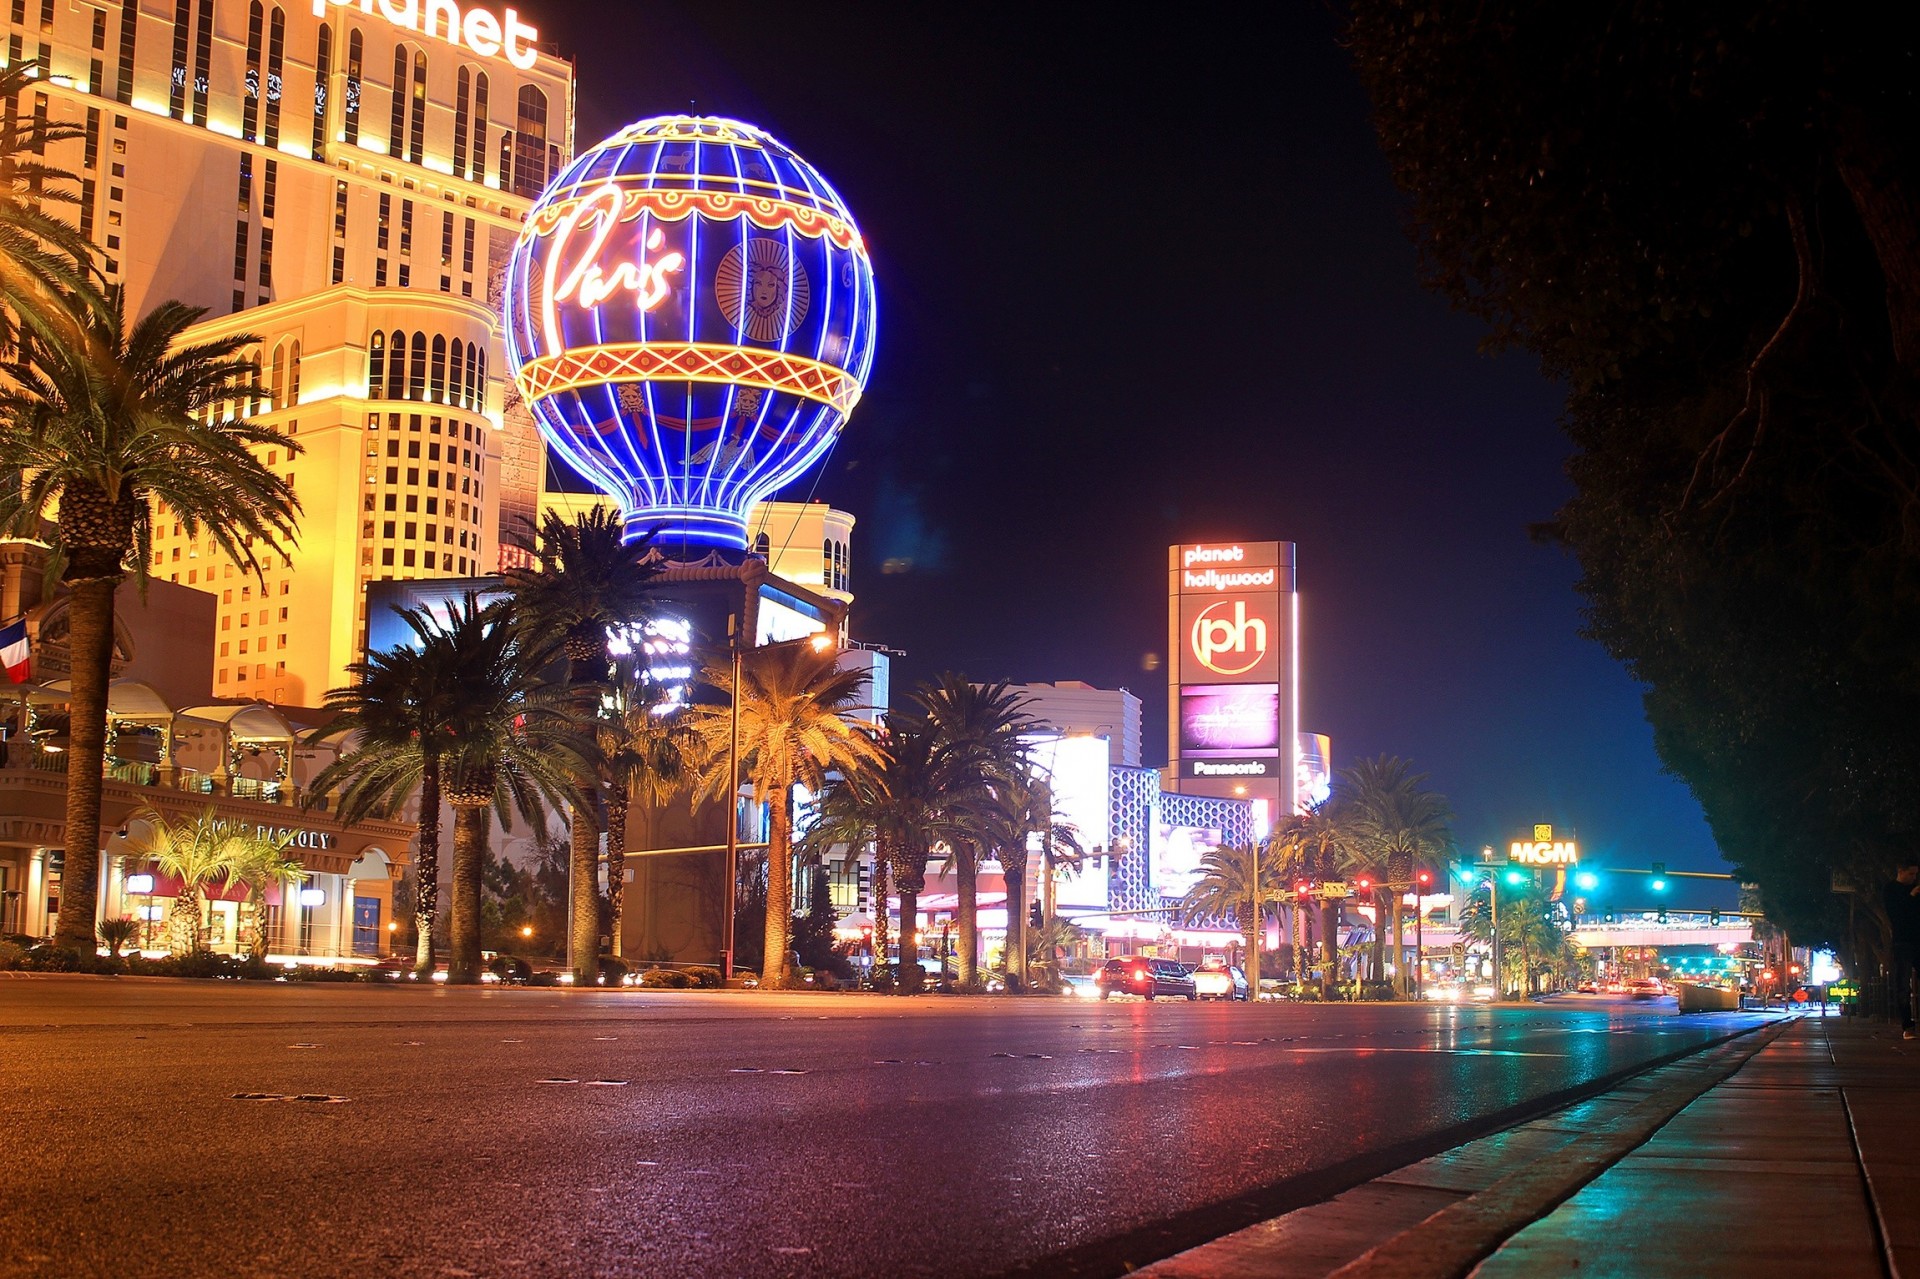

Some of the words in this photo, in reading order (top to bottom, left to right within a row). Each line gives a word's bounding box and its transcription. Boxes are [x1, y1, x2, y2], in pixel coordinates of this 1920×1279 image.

[313, 0, 538, 70] anet
[542, 184, 682, 358] Paris
[1185, 545, 1243, 567] planet
[1185, 568, 1274, 591] hollywood
[1201, 601, 1267, 666] ph
[1193, 761, 1266, 775] Panasonic
[1510, 842, 1577, 863] MGM
